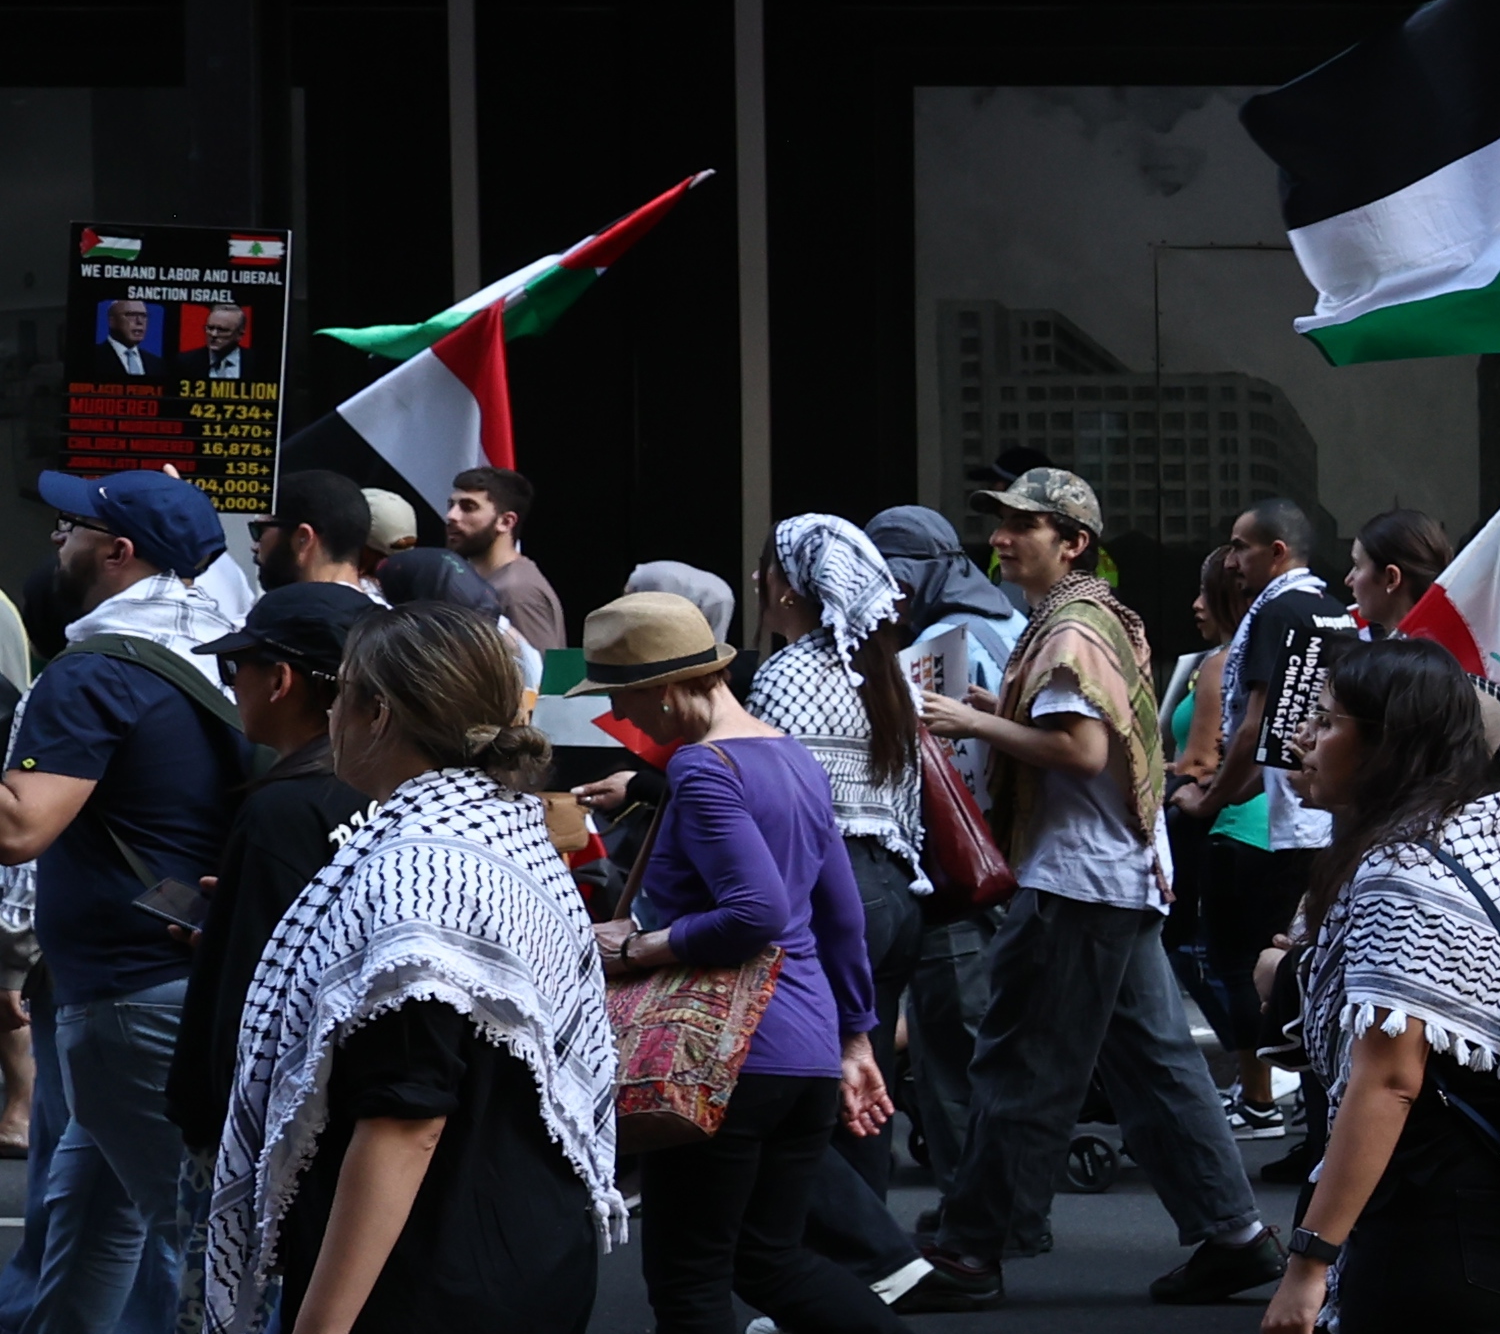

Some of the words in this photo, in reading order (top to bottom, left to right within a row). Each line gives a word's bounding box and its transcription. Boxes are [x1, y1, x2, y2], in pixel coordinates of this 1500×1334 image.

[80, 263, 101, 278] WE
[104, 265, 157, 281] DEMAND
[158, 267, 200, 282] LABOR
[203, 268, 228, 284] AND
[231, 269, 284, 286] LIBERAL
[126, 285, 188, 302] SANCTION
[190, 287, 236, 304] ISRAEL
[178, 378, 207, 399] 3.2
[210, 380, 279, 401] MILLION
[67, 397, 161, 417] MURDERED
[188, 402, 274, 421] 42,734+
[201, 422, 273, 439] 11,470+
[201, 441, 273, 458] 16,875+
[224, 461, 271, 476] 135+
[1297, 635, 1323, 693] MIDDLE
[1269, 653, 1302, 740] CHILDREN?
[1280, 692, 1306, 765] EASTERN
